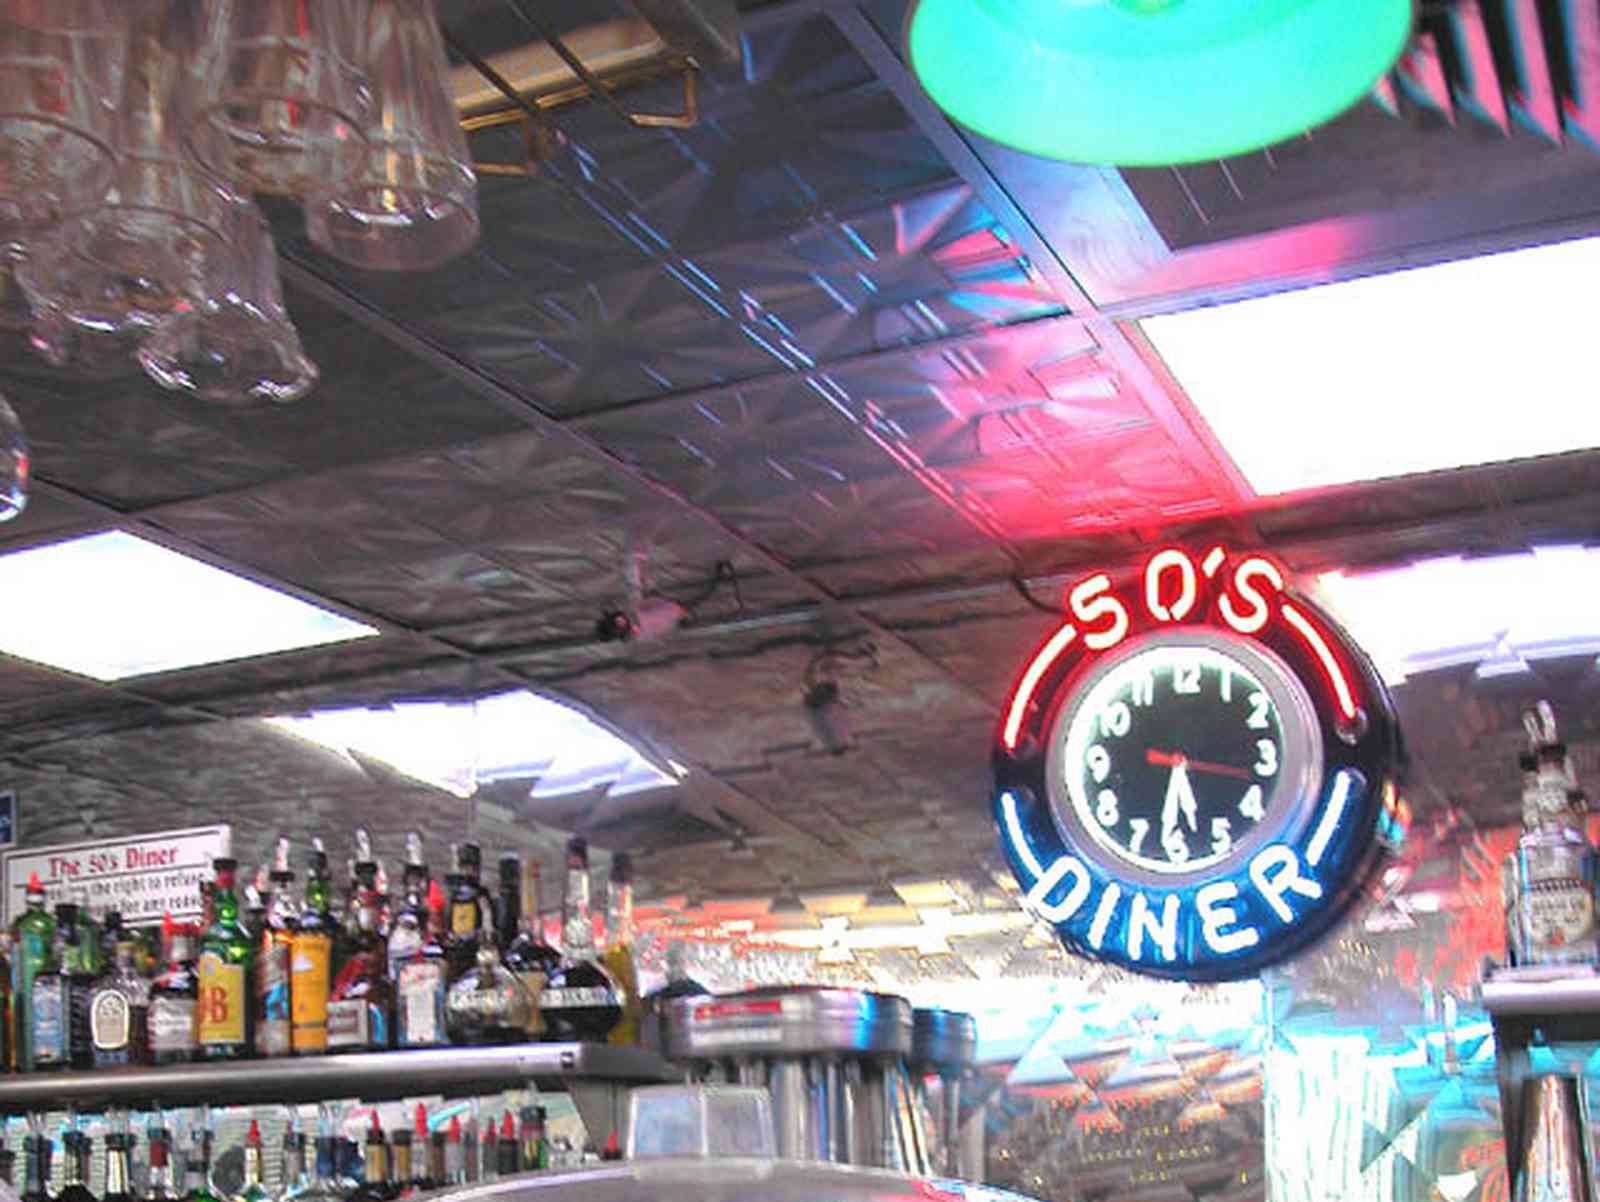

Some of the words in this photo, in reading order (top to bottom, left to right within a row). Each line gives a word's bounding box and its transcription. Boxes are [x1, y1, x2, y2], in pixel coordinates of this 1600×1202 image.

[1069, 547, 1283, 651] 50'S
[1173, 664, 1202, 694] 12
[1098, 701, 1131, 738] 10
[1246, 692, 1269, 729] 2
[1088, 744, 1111, 784] 9
[1253, 739, 1278, 777] 3
[1096, 788, 1120, 827] 8
[1237, 785, 1265, 822] 4
[1128, 817, 1149, 854] 7
[1167, 826, 1189, 864] 6
[1211, 817, 1232, 854] 5
[48, 856, 81, 880] The
[126, 846, 177, 870] Diner
[1025, 843, 1322, 961] DINER
